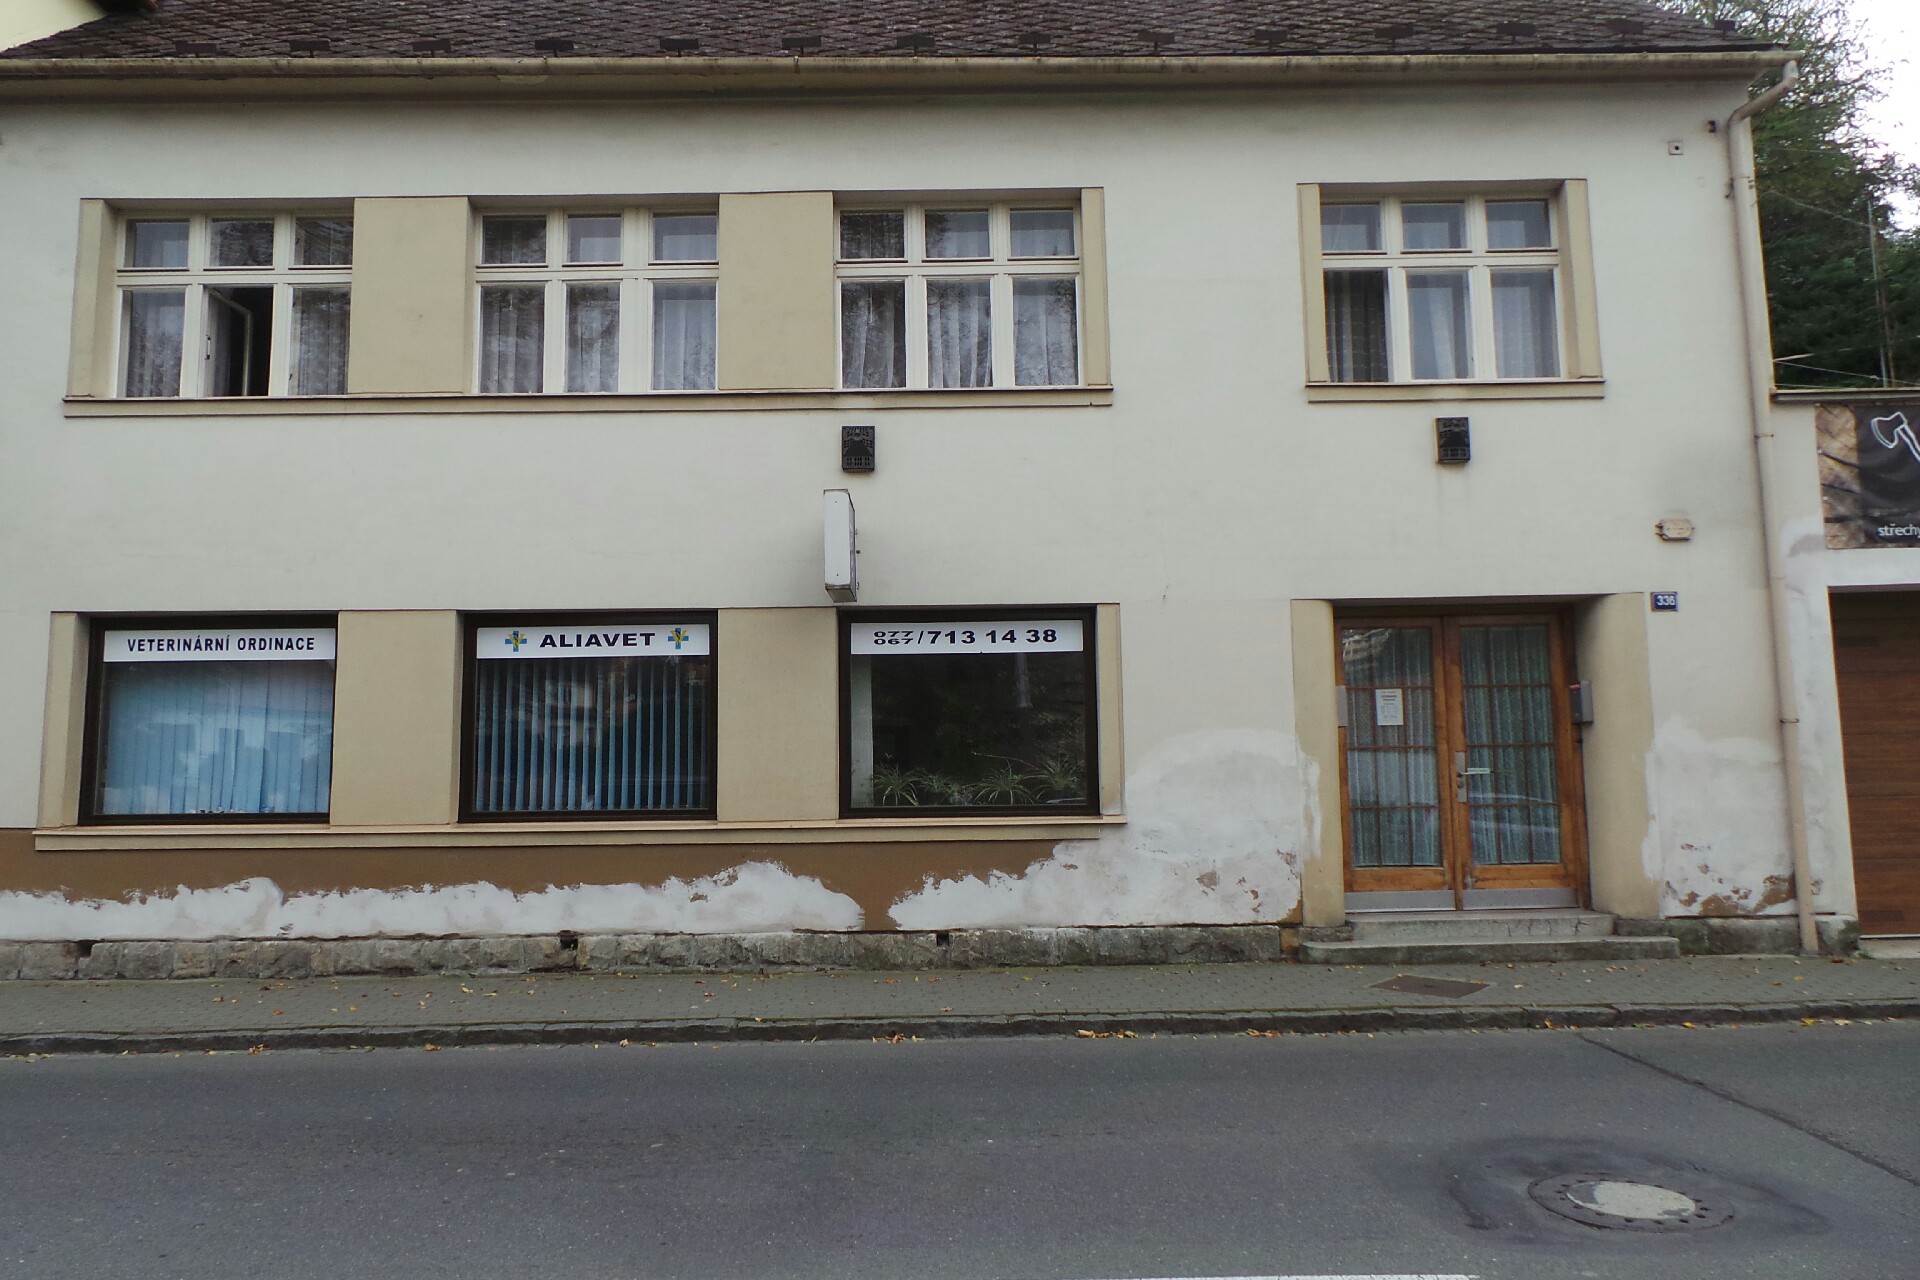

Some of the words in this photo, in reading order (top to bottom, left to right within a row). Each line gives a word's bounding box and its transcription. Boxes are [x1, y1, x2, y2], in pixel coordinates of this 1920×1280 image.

[127, 634, 231, 652] VETERINÁRNÍ
[237, 636, 316, 651] ORDINACE
[539, 632, 656, 648] ALIAVET
[985, 629, 1018, 644] 14
[1026, 628, 1058, 643] 38
